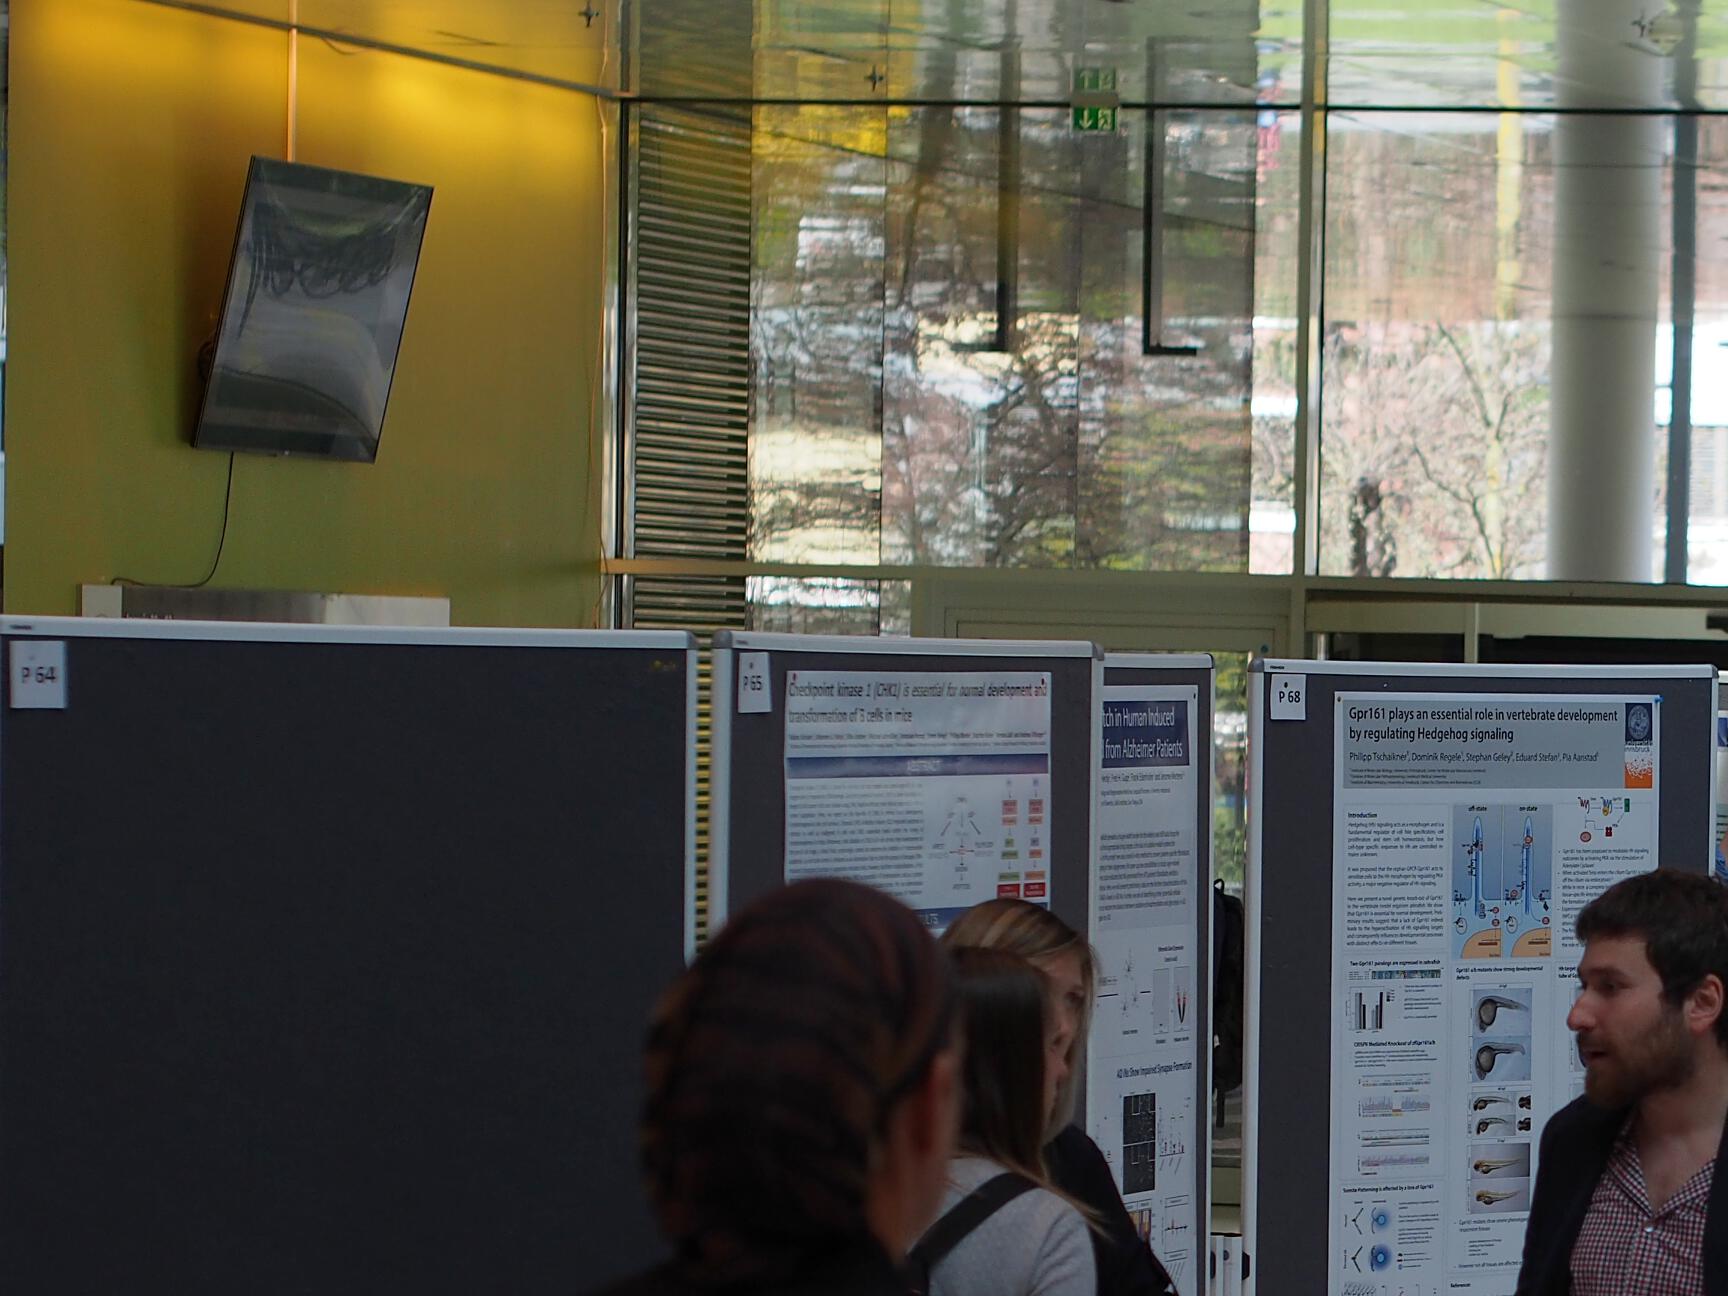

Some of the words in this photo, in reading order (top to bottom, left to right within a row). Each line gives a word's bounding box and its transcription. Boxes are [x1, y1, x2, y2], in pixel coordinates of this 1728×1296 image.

[22, 667, 31, 684] P
[36, 667, 57, 684] 64
[743, 675, 749, 691] P
[750, 675, 763, 691] 65
[789, 682, 834, 700] Checkpoint
[837, 682, 864, 697] kinase
[902, 683, 909, 697] is
[911, 682, 944, 697] essential
[945, 682, 957, 697] for
[959, 682, 986, 697] normal
[987, 682, 1033, 700] development
[1034, 682, 1047, 697] and
[1279, 690, 1286, 704] P
[1288, 690, 1301, 704] 68
[789, 707, 848, 723] transformation
[848, 707, 858, 723] of
[867, 707, 884, 723] cells
[885, 708, 893, 723] in
[894, 708, 913, 723] mice
[1115, 707, 1122, 727] in
[1123, 706, 1147, 727] Human
[1148, 706, 1175, 727] Induced
[1348, 706, 1385, 722] Gpr161
[1388, 707, 1414, 723] plays
[1416, 710, 1428, 720] an
[1430, 707, 1473, 721] essential
[1475, 708, 1493, 721] role
[1495, 708, 1504, 721] in
[1506, 708, 1555, 721] vertebrate
[1557, 708, 1618, 724] development
[1349, 726, 1362, 742] by
[1363, 726, 1415, 743] regulating
[1418, 727, 1468, 743] Hedgehog
[1470, 727, 1514, 743] signaling
[1105, 738, 1121, 759] from
[1122, 738, 1156, 759] Alzheimer
[1156, 738, 1183, 759] Patients
[1411, 752, 1438, 762] Dominik
[1466, 752, 1492, 764] Stephan
[1515, 752, 1538, 762] Eduard
